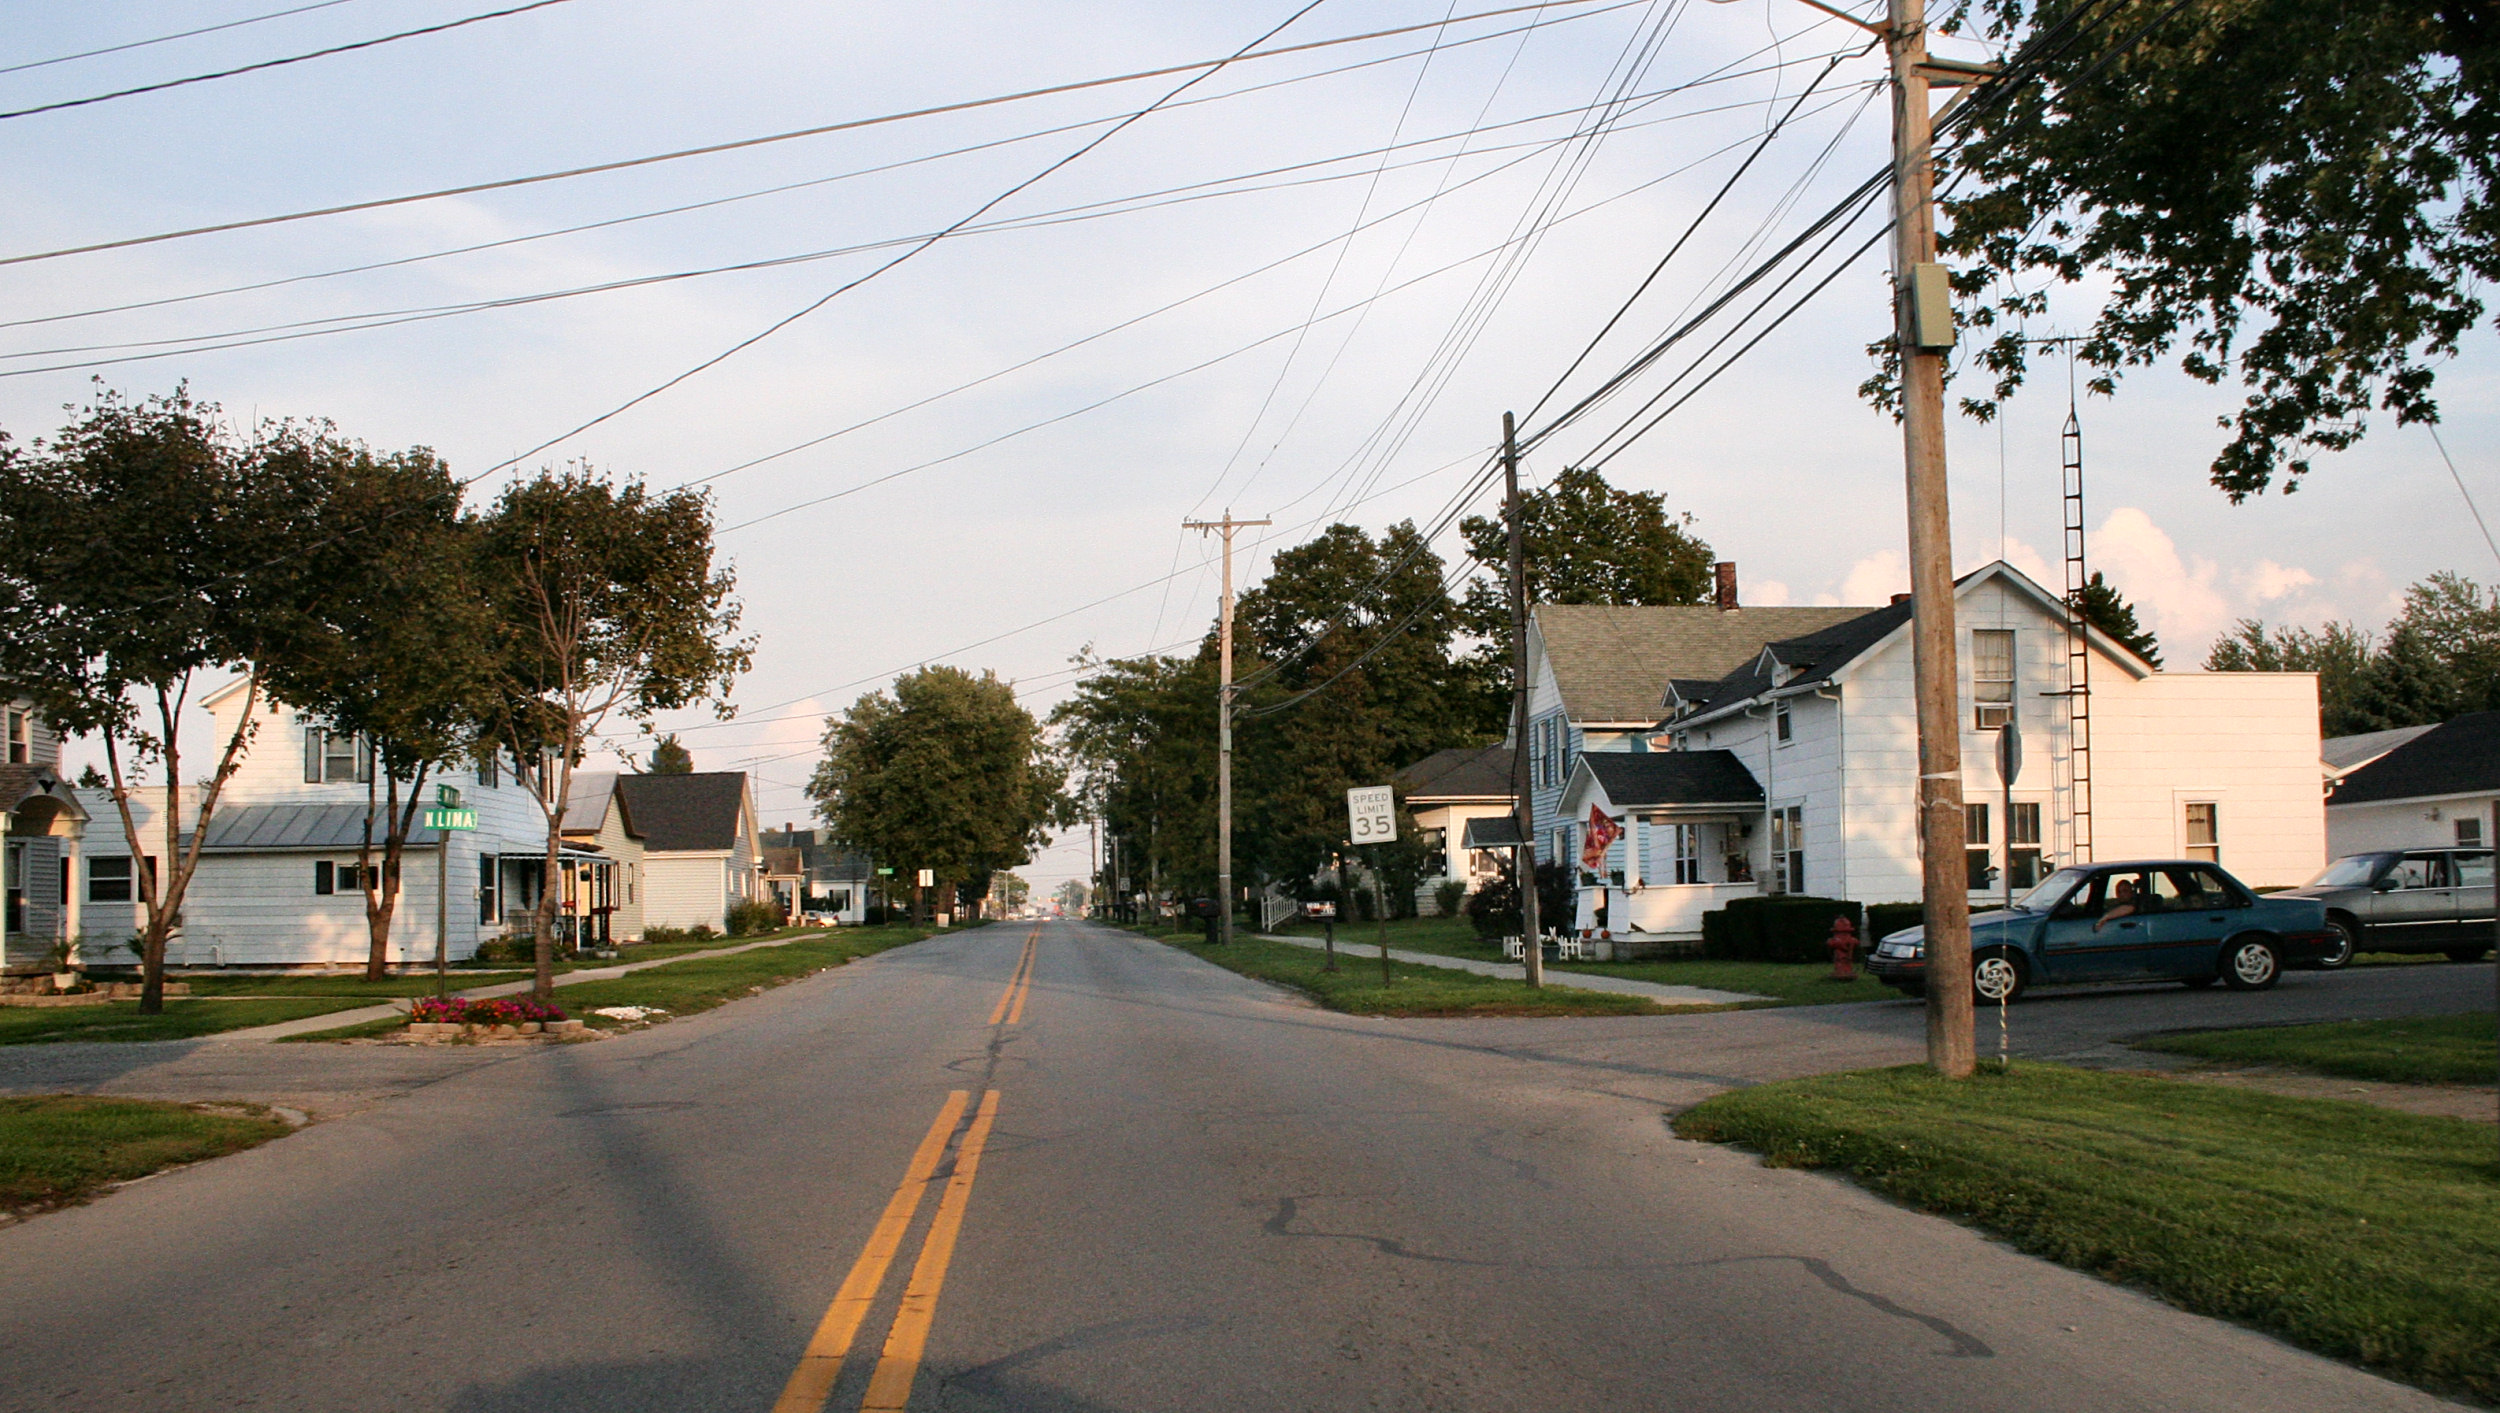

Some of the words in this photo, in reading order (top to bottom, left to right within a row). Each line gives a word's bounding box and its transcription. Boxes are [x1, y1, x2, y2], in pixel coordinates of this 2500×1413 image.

[1353, 793, 1389, 804] SPEED
[1357, 805, 1385, 815] LIMIT
[425, 811, 434, 828] N
[437, 811, 473, 828] LIMA
[1356, 816, 1391, 836] 35
